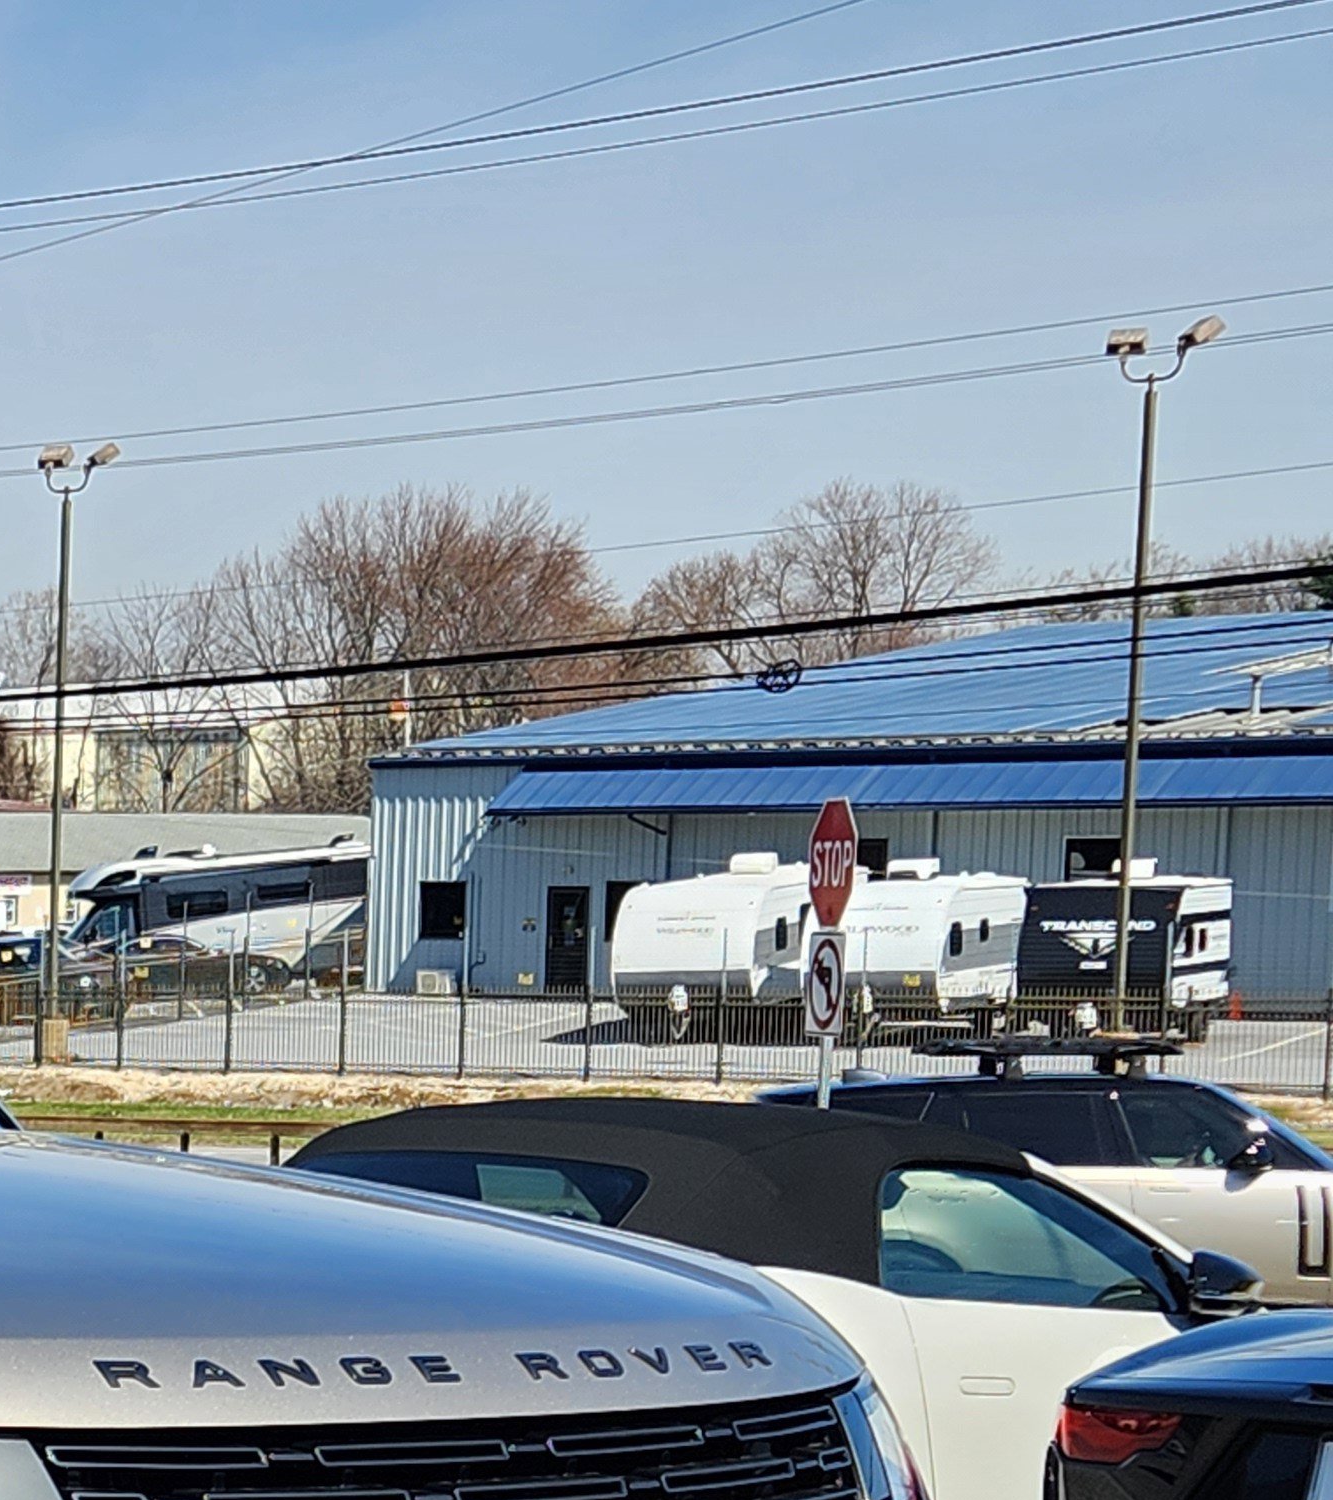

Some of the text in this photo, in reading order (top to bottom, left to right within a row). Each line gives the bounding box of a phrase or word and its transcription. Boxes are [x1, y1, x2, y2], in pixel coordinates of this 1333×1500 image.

[812, 840, 852, 888] STOP
[1039, 919, 1157, 931] TRANSCND
[91, 1341, 773, 1389] RANGE ROVER
